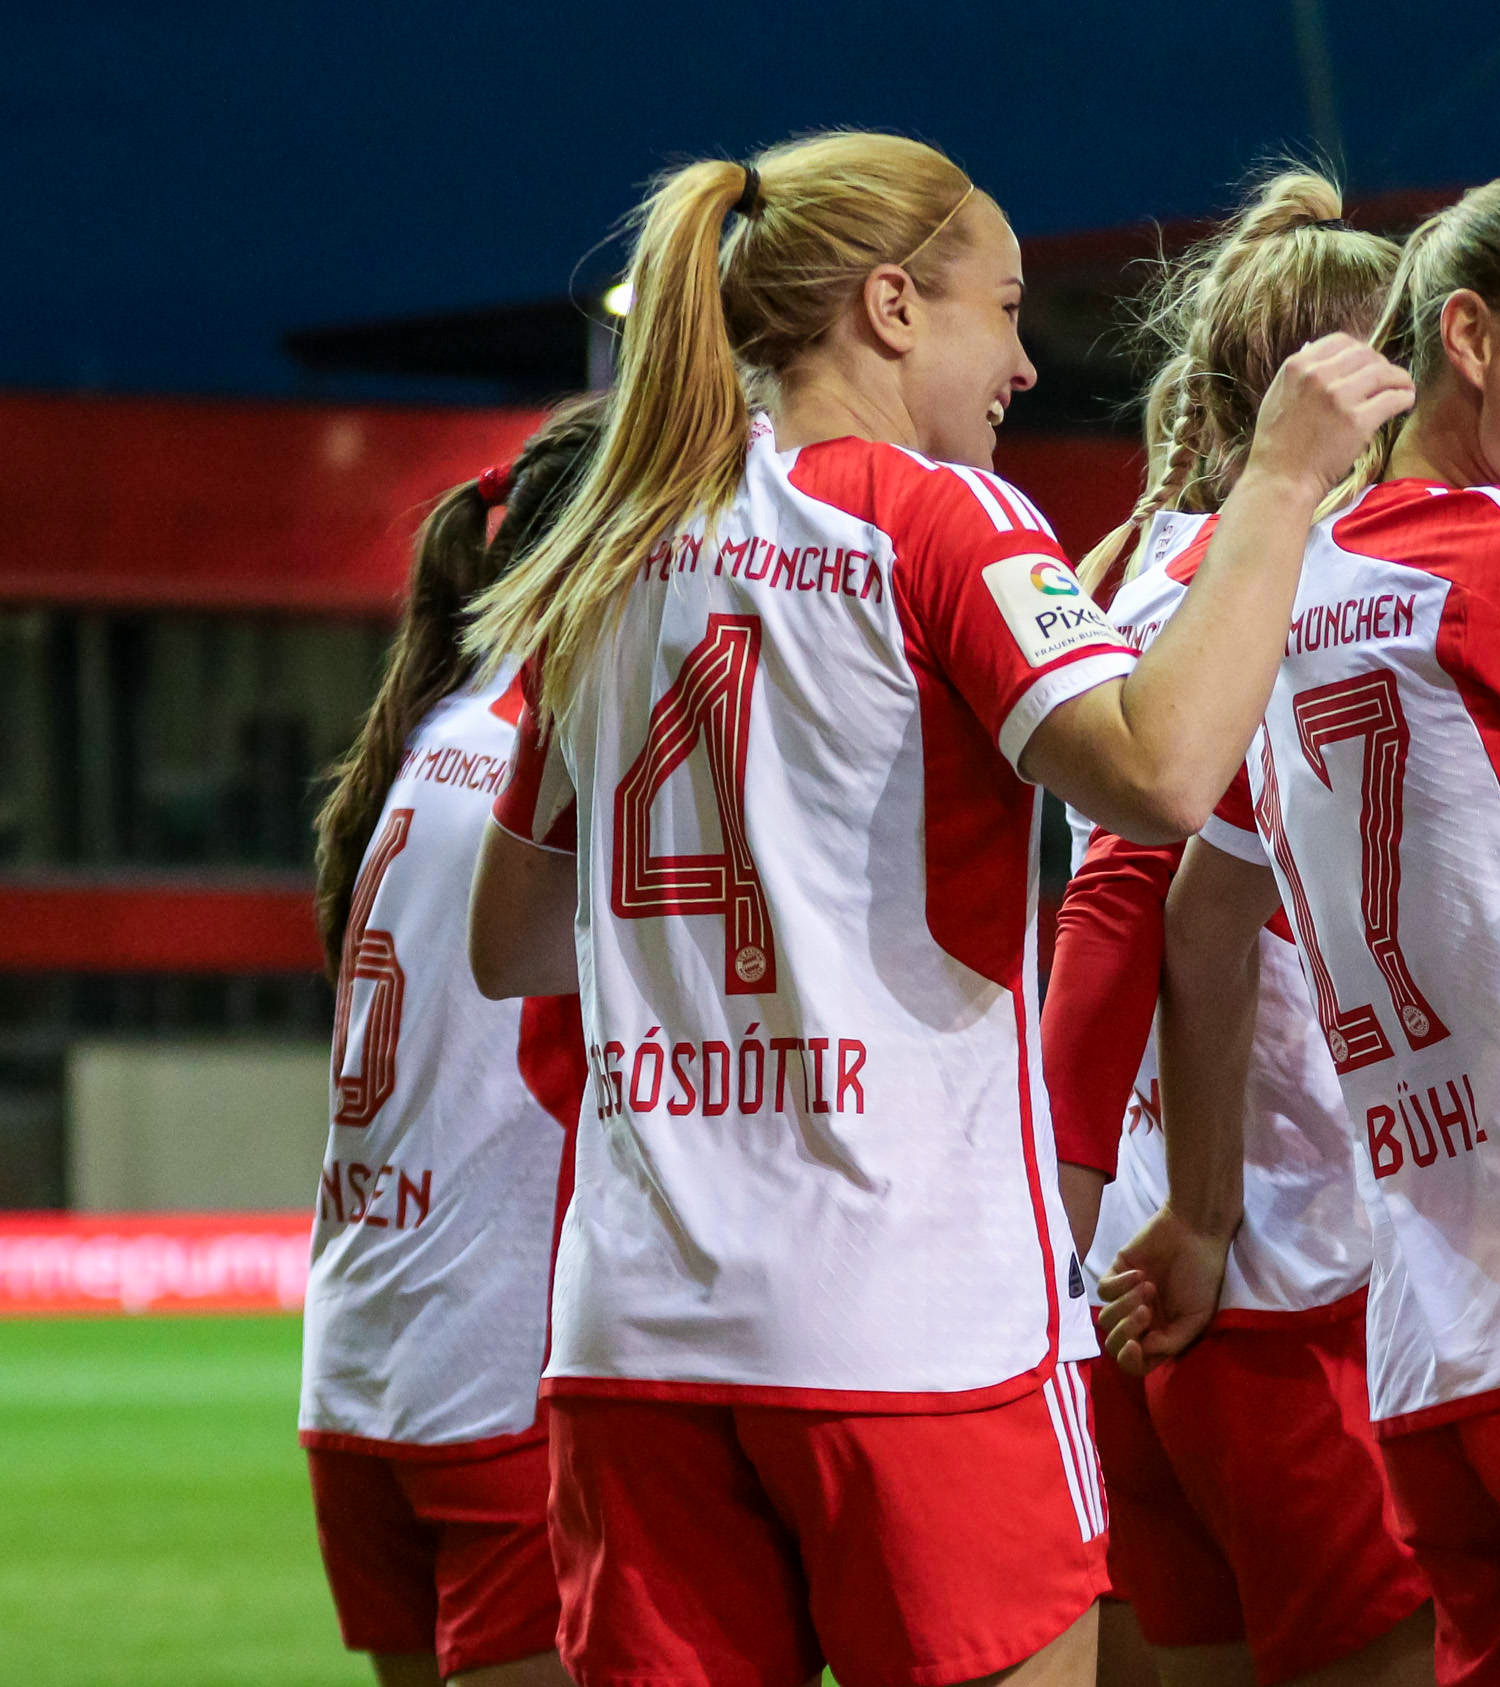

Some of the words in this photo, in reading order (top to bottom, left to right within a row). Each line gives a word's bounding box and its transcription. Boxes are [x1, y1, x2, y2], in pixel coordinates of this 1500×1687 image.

[714, 536, 883, 604] MÜNCHEN
[1284, 594, 1417, 657] MÜNCHEN
[612, 613, 777, 995] 4
[1254, 668, 1452, 1076] 17
[334, 808, 415, 1127] 6
[1366, 1073, 1488, 1180] BÜHL
